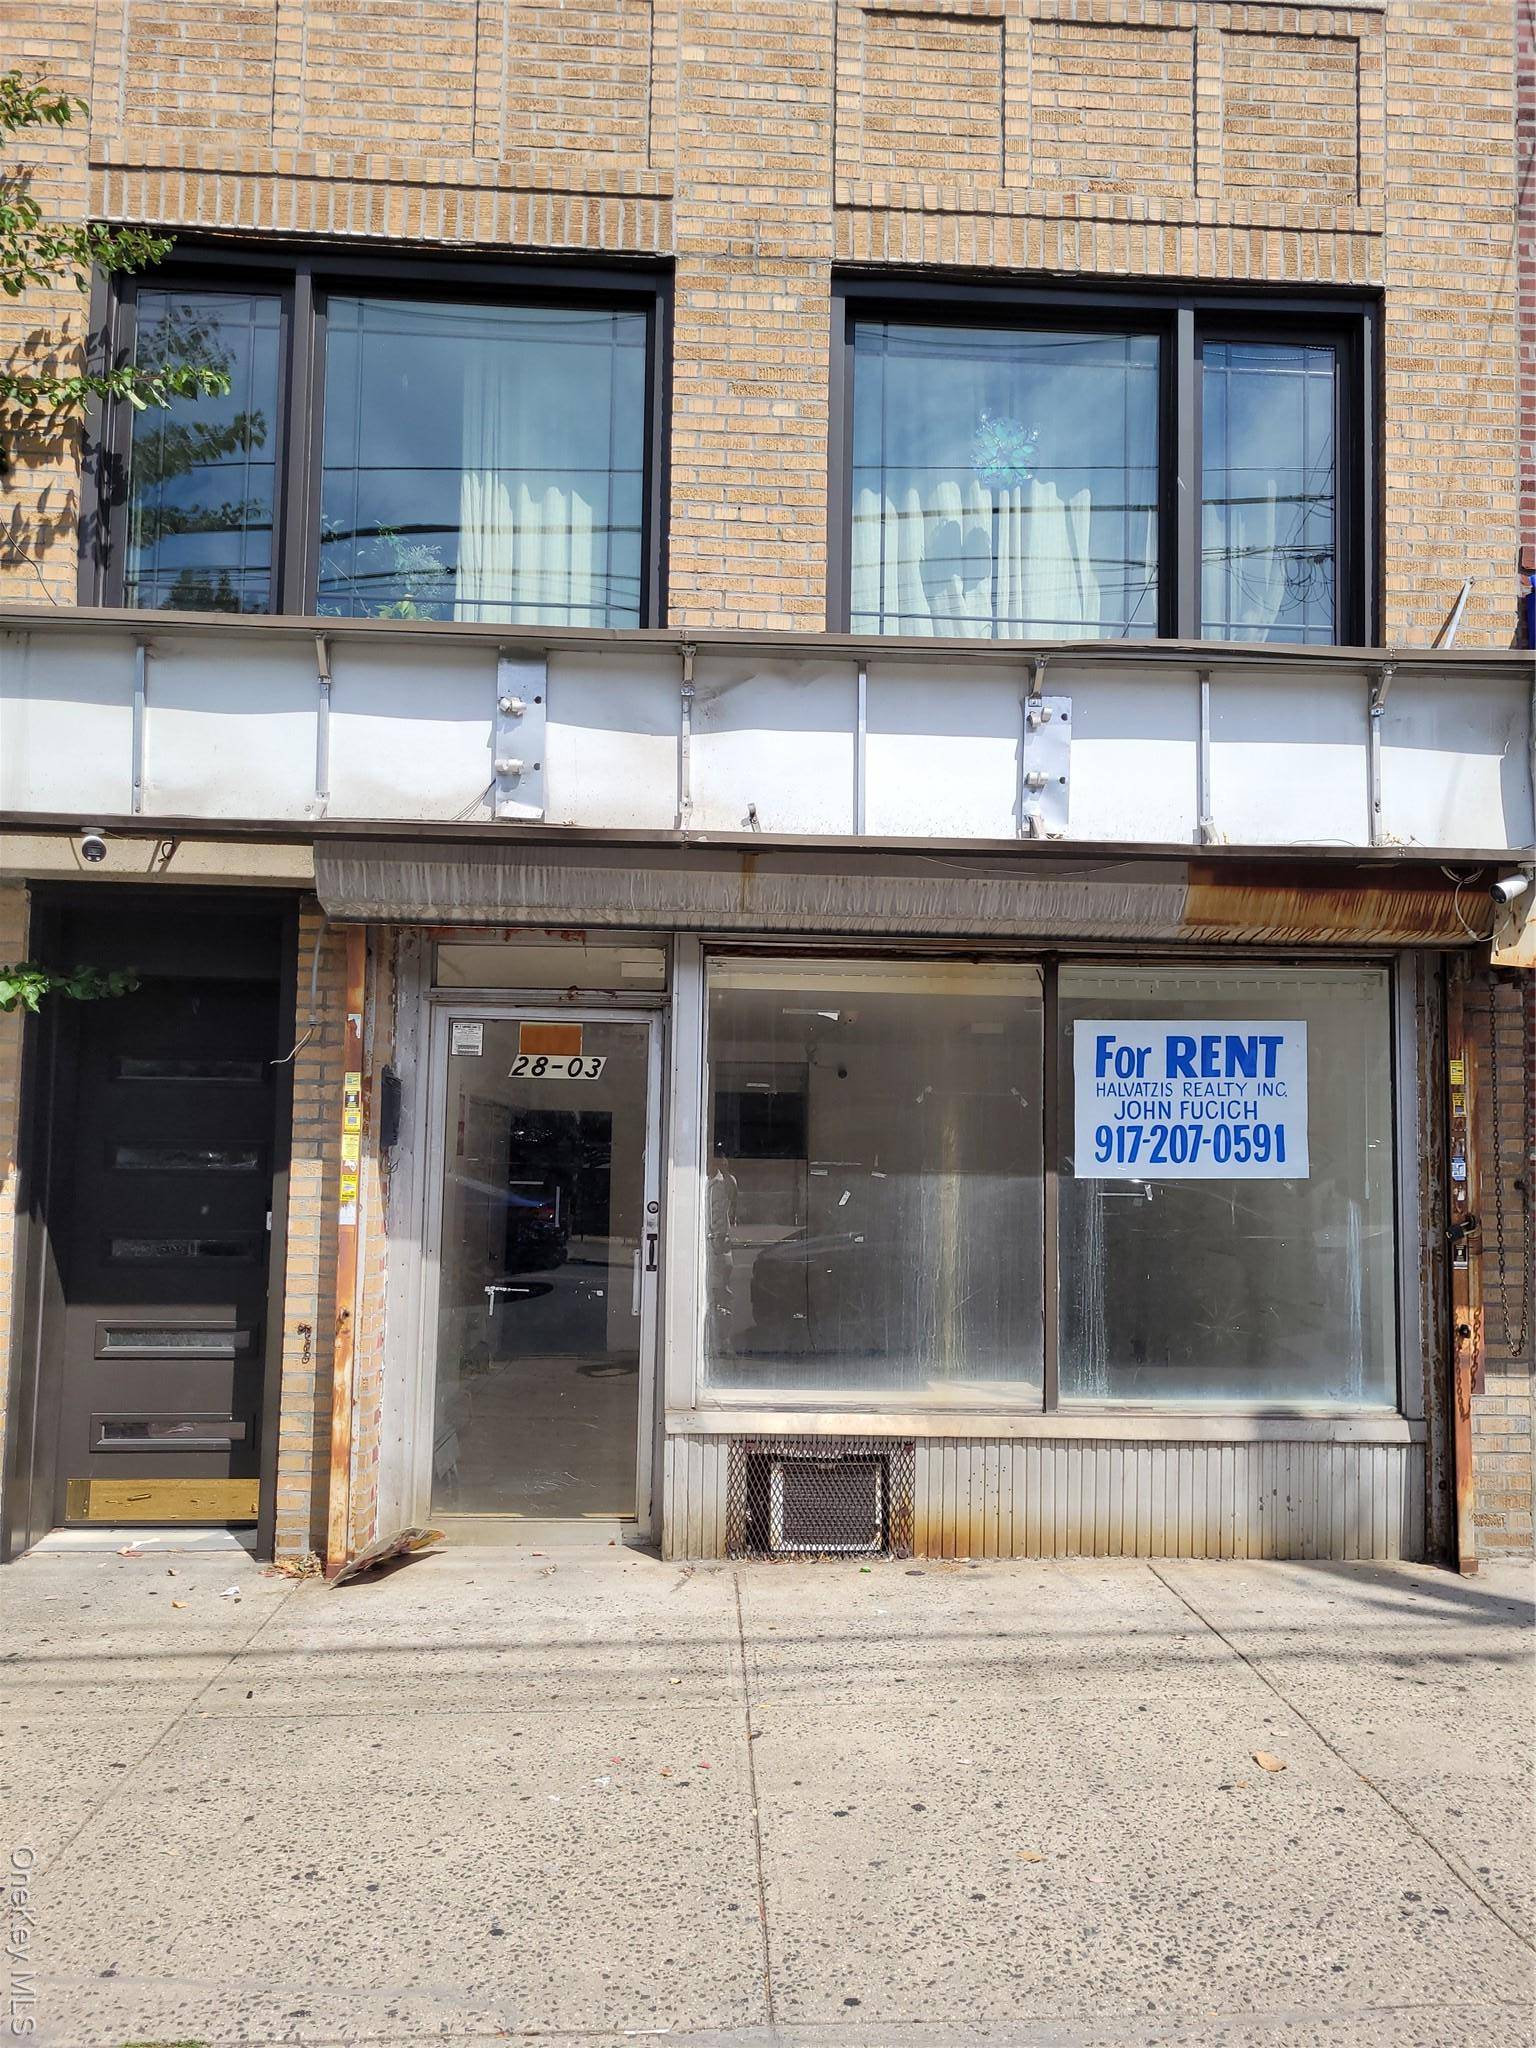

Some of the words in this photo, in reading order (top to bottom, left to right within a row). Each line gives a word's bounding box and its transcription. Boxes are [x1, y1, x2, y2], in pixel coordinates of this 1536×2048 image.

[511, 1056, 602, 1078] 28-03
[1095, 1035, 1152, 1079] For
[1165, 1035, 1284, 1078] RENT
[1096, 1082, 1173, 1097] HALVATZIS
[1183, 1082, 1248, 1097] REALTY
[1114, 1100, 1171, 1120] JOHN
[1180, 1100, 1258, 1120] FUCICH
[1094, 1123, 1286, 1163] 917-207-0591
